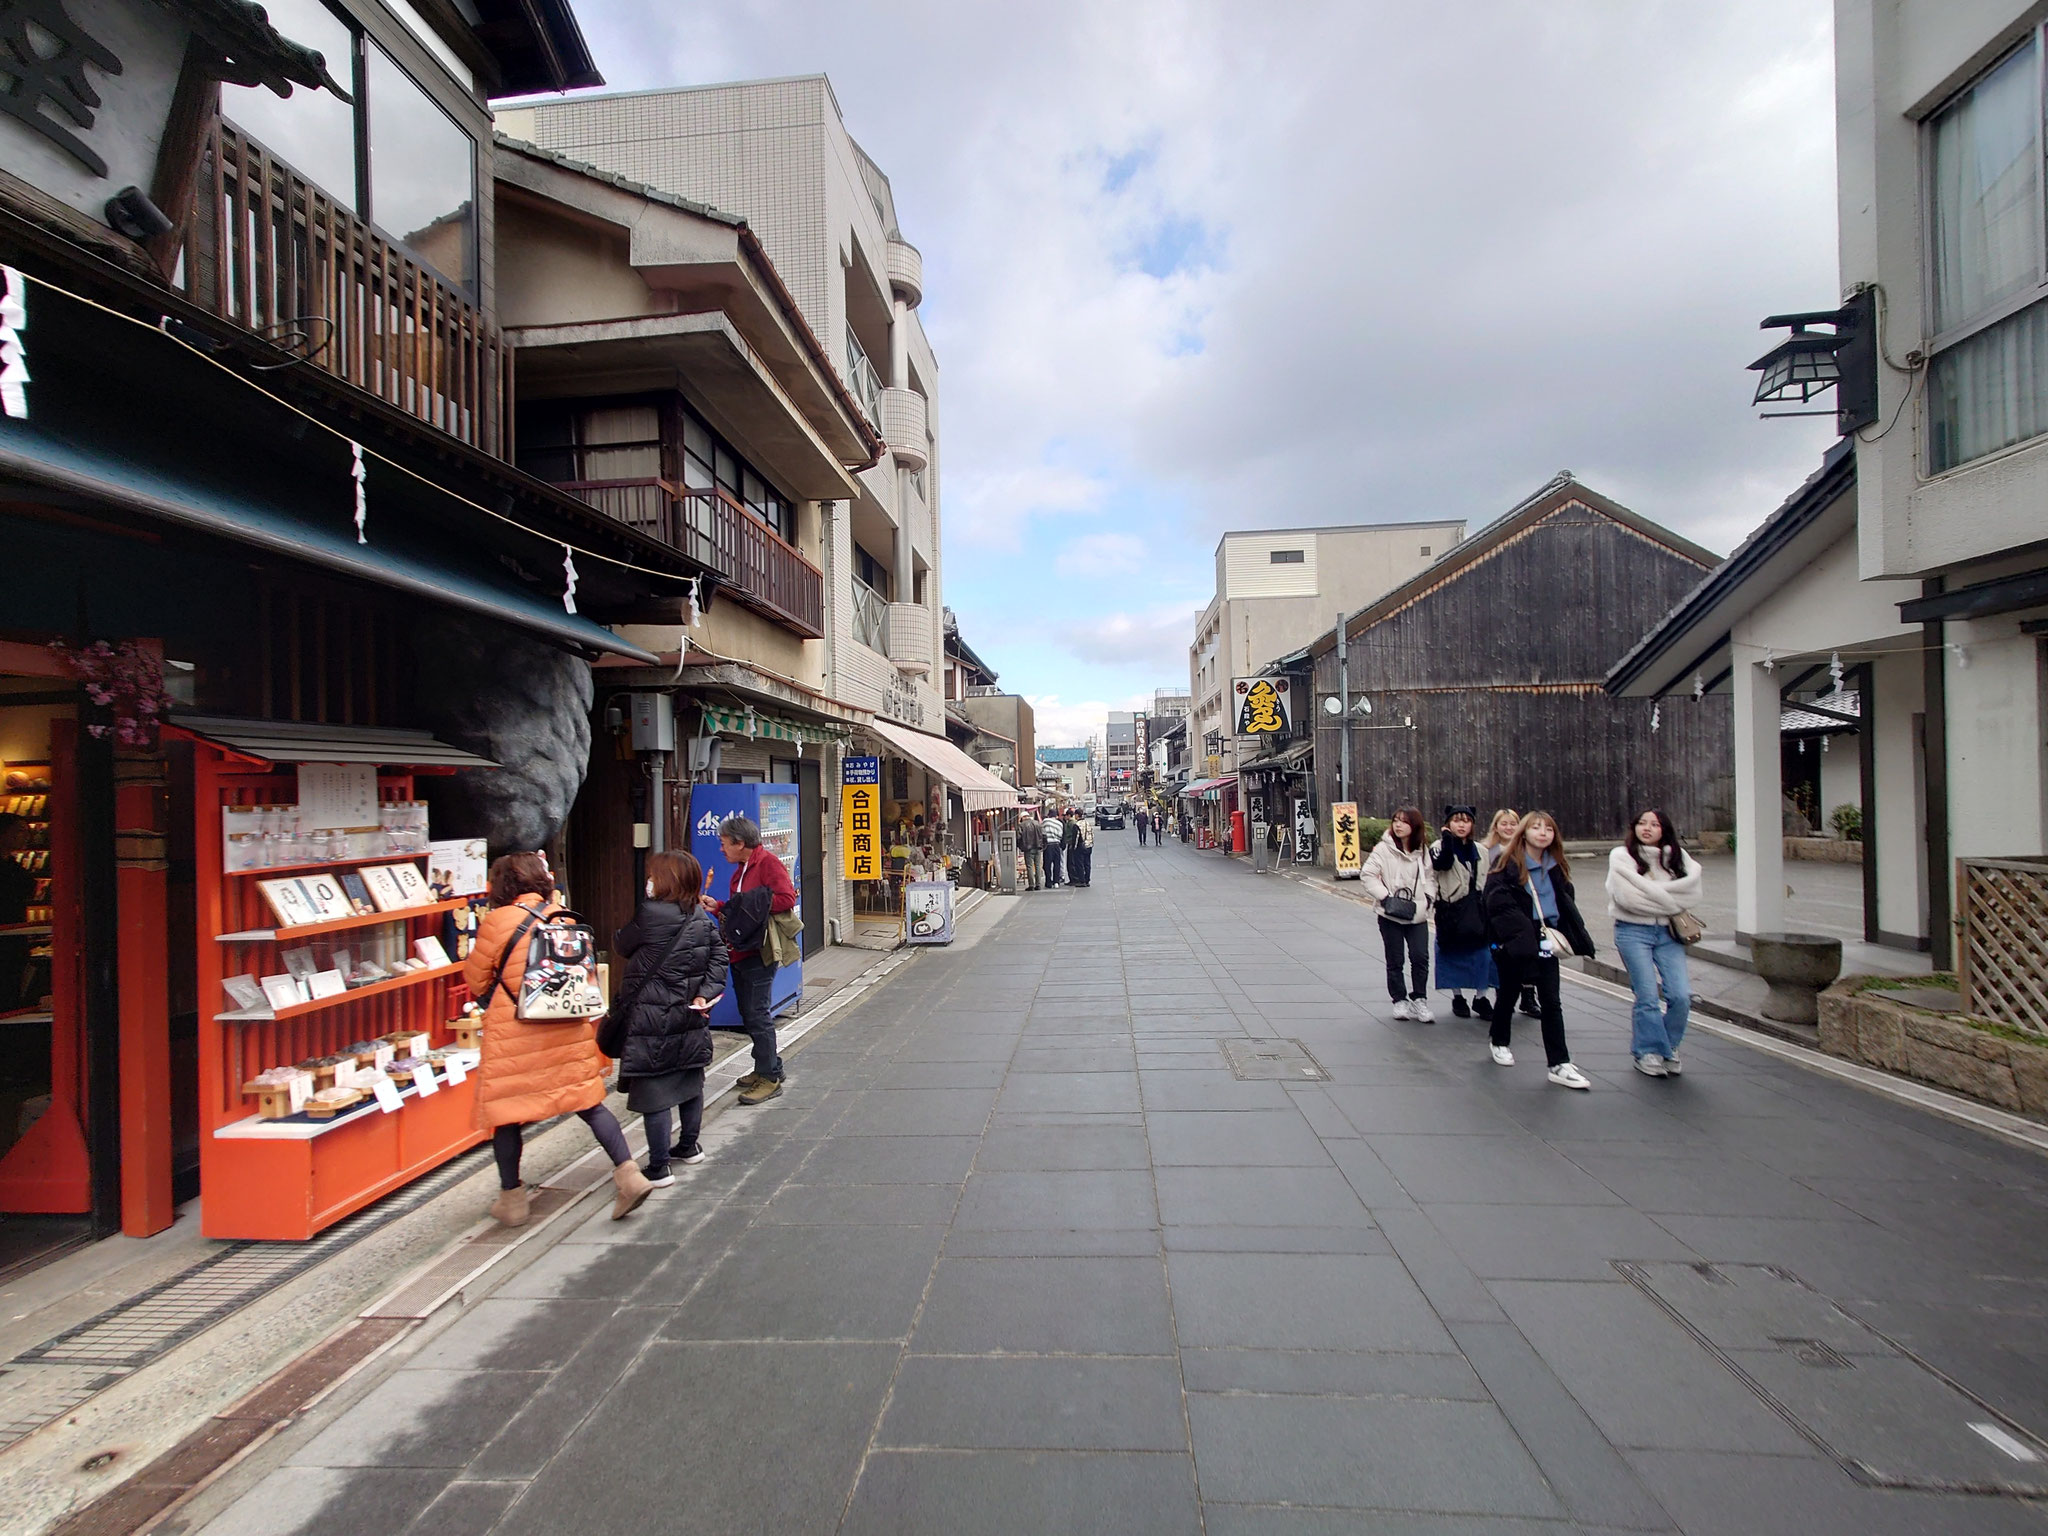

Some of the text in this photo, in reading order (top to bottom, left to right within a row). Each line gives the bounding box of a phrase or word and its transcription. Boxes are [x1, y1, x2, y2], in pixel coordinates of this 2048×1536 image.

[851, 789, 872, 875] 合田商店
[1336, 813, 1356, 862] 灸まん
